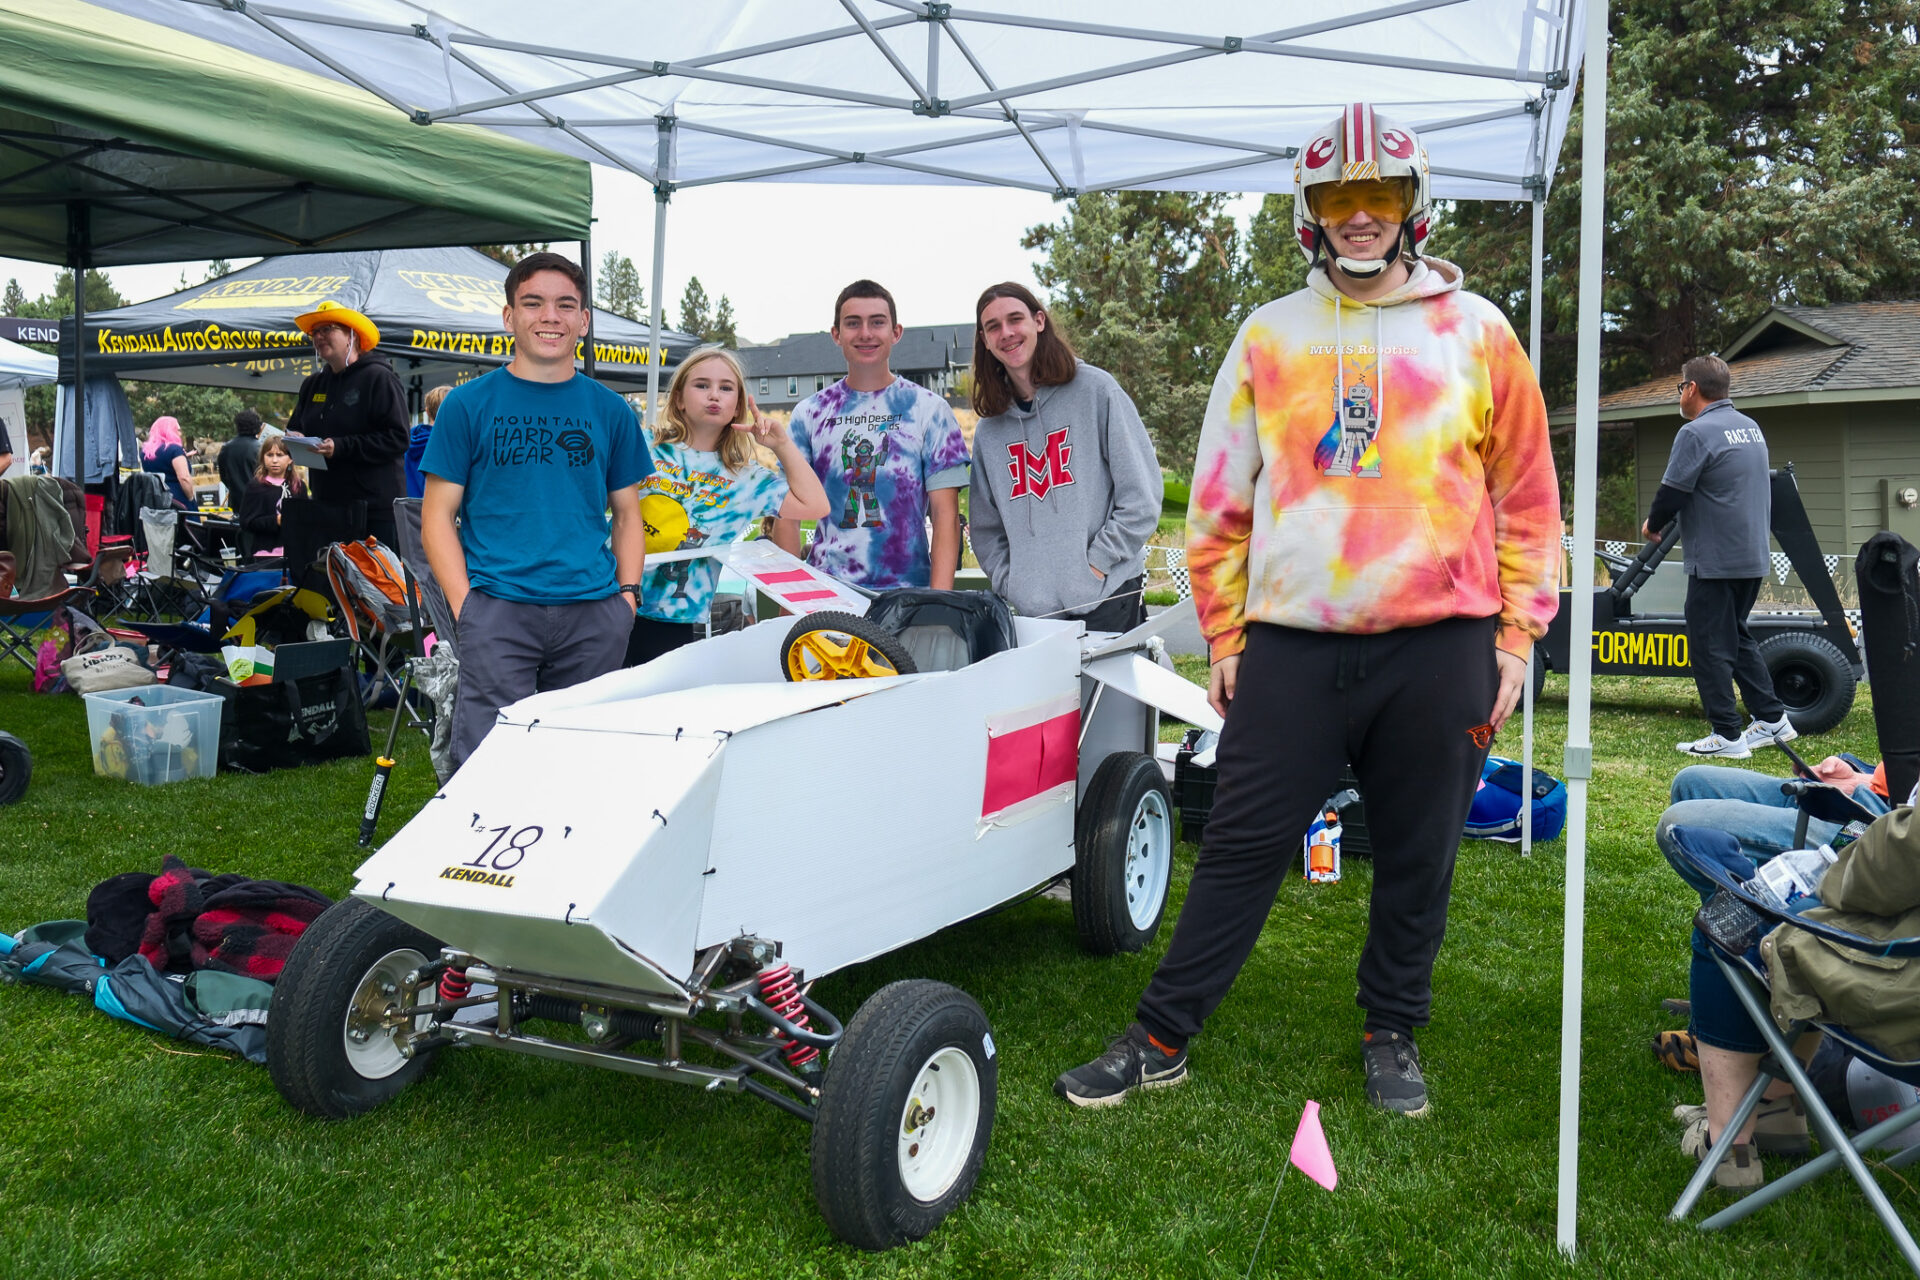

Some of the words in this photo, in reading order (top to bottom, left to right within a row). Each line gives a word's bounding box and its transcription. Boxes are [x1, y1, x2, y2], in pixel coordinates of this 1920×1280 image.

[411, 329, 487, 355] DRIVEN
[491, 335, 515, 356] BY
[1358, 345, 1417, 355] Rootics
[493, 415, 593, 430] MOUNTAIN
[844, 413, 867, 426] High
[868, 413, 902, 424] Desert
[493, 427, 553, 447] HARD
[1724, 428, 1751, 445] RACE
[493, 446, 553, 467] WEAR
[687, 470, 735, 490] DESERT
[695, 489, 730, 509] 753
[367, 779, 382, 815] ROCKER
[439, 866, 516, 888] KENDALL
